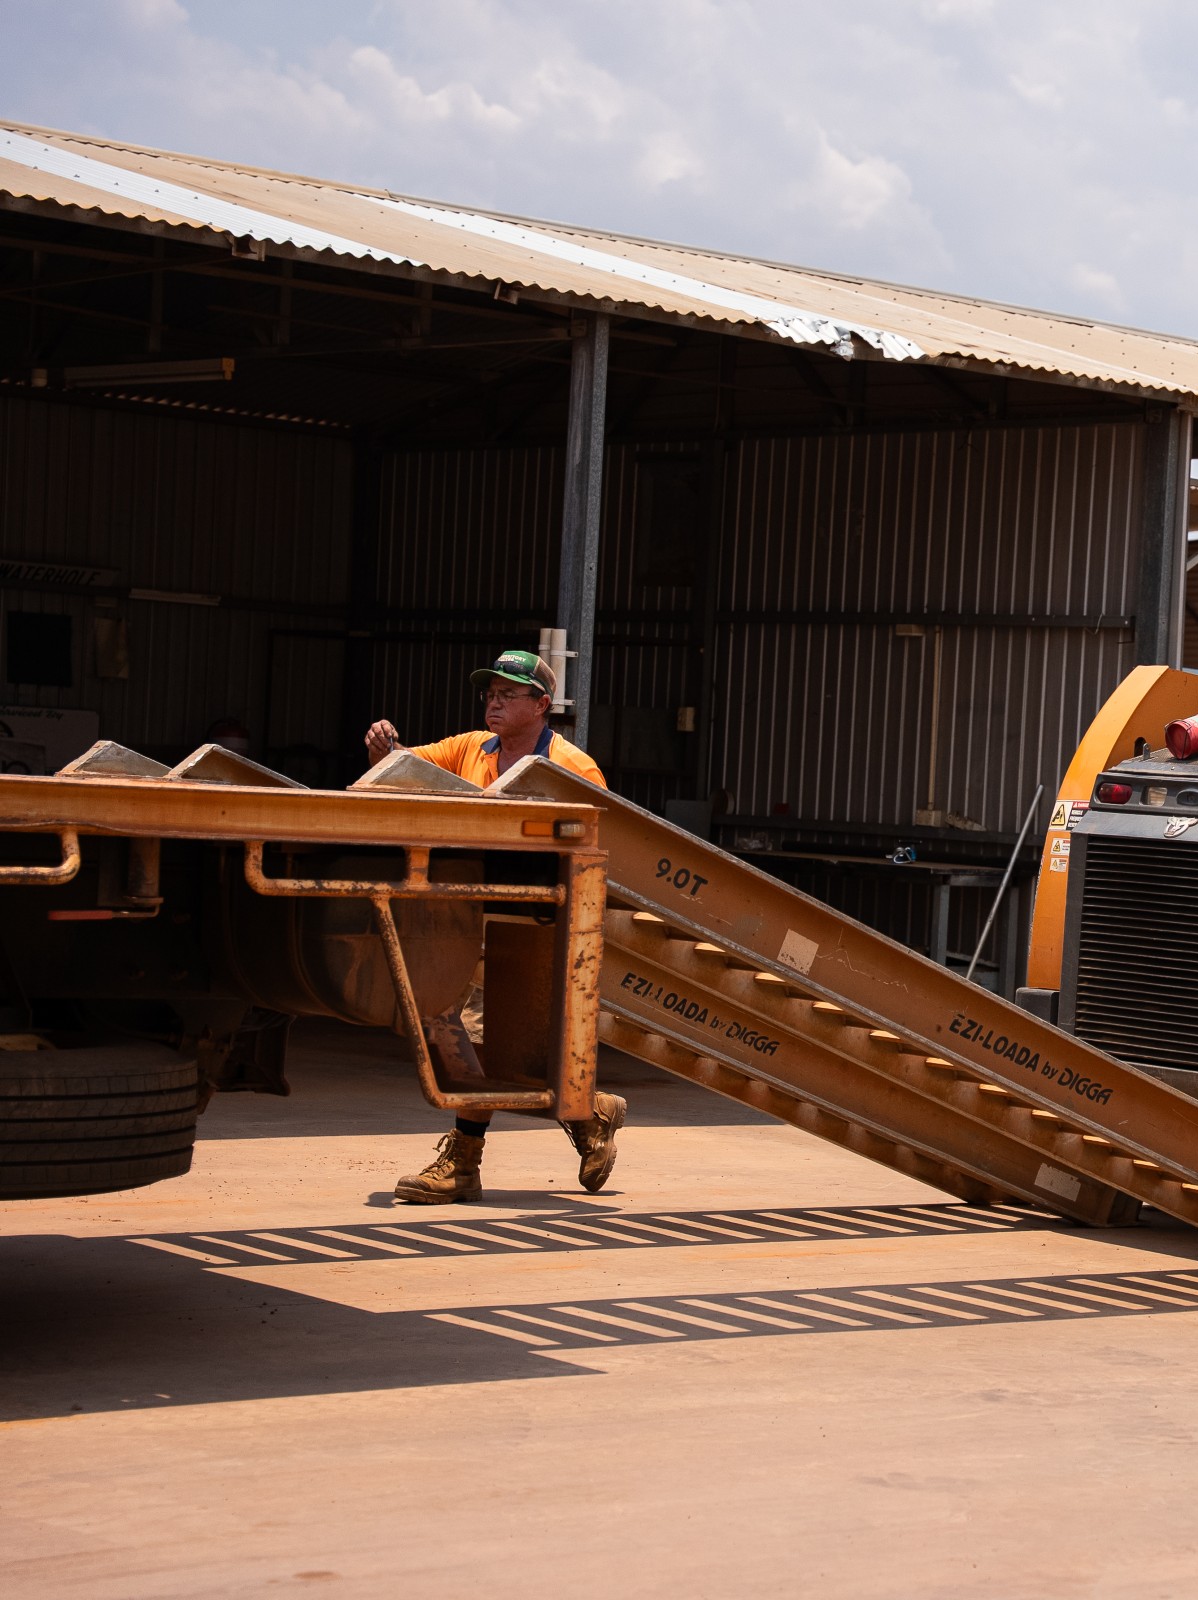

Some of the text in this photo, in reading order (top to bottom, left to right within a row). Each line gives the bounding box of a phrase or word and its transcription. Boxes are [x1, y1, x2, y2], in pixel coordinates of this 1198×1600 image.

[656, 858, 708, 896] 9.0T
[725, 1021, 781, 1056] DIGGA
[1041, 1061, 1059, 1080] by
[1057, 1067, 1114, 1105] DIGGA
